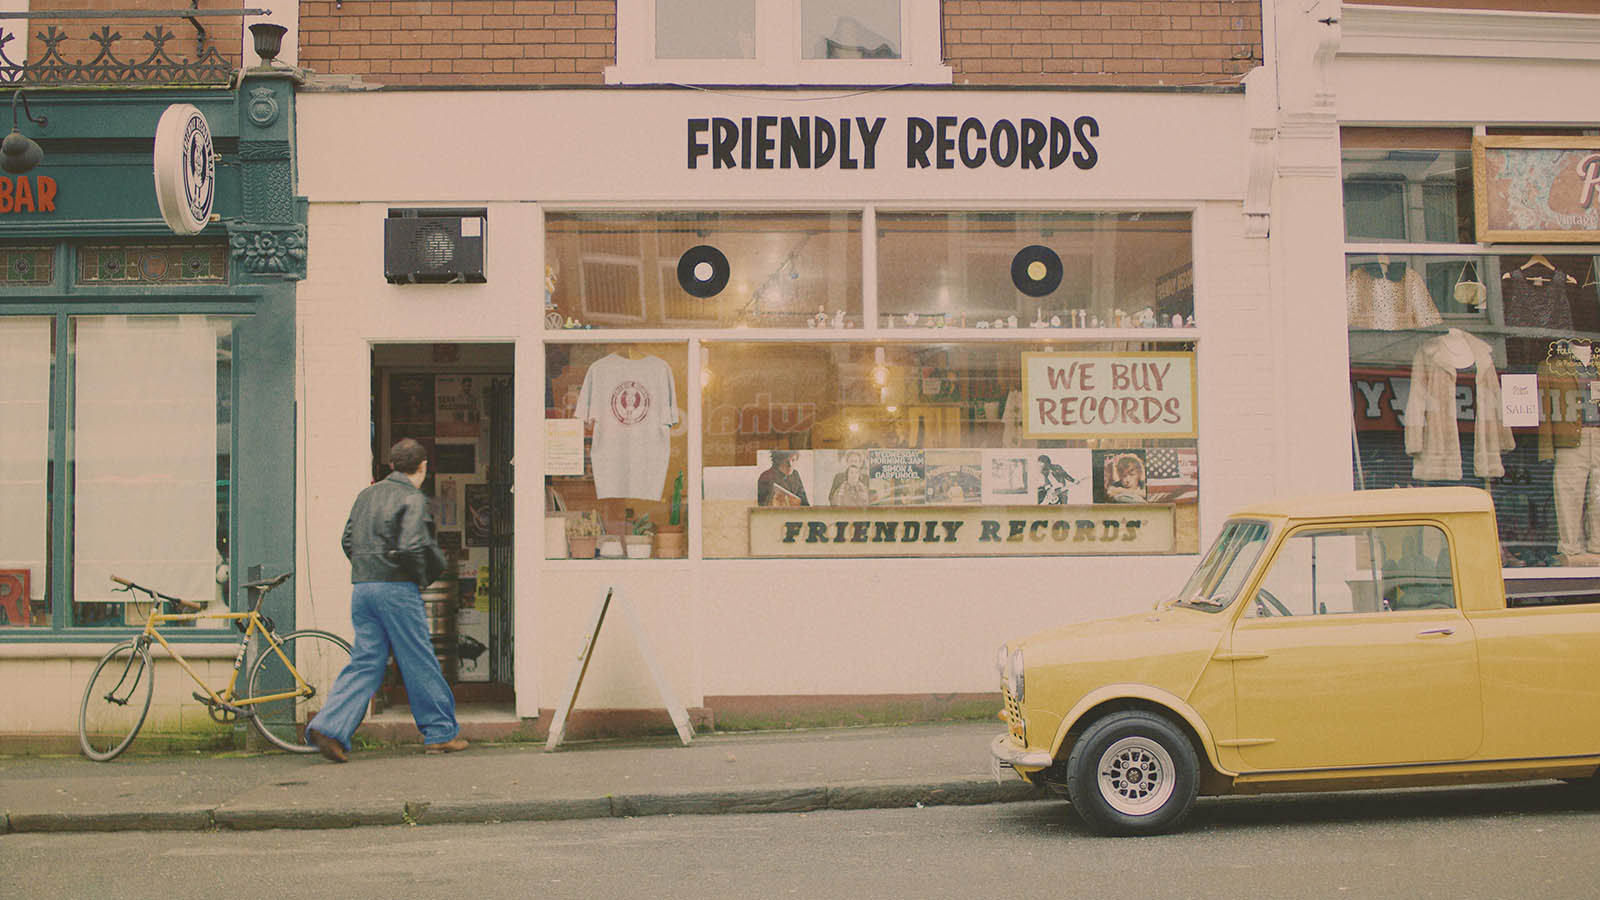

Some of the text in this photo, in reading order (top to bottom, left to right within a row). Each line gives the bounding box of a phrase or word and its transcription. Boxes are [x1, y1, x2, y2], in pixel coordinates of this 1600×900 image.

[687, 115, 1100, 170] FRIENDLY RECORDS
[0, 175, 57, 213] BAR
[1047, 361, 1171, 391] WE BUY
[1035, 396, 1181, 426] RECORDS
[782, 519, 1141, 544] FRIENDLY RECORDS
